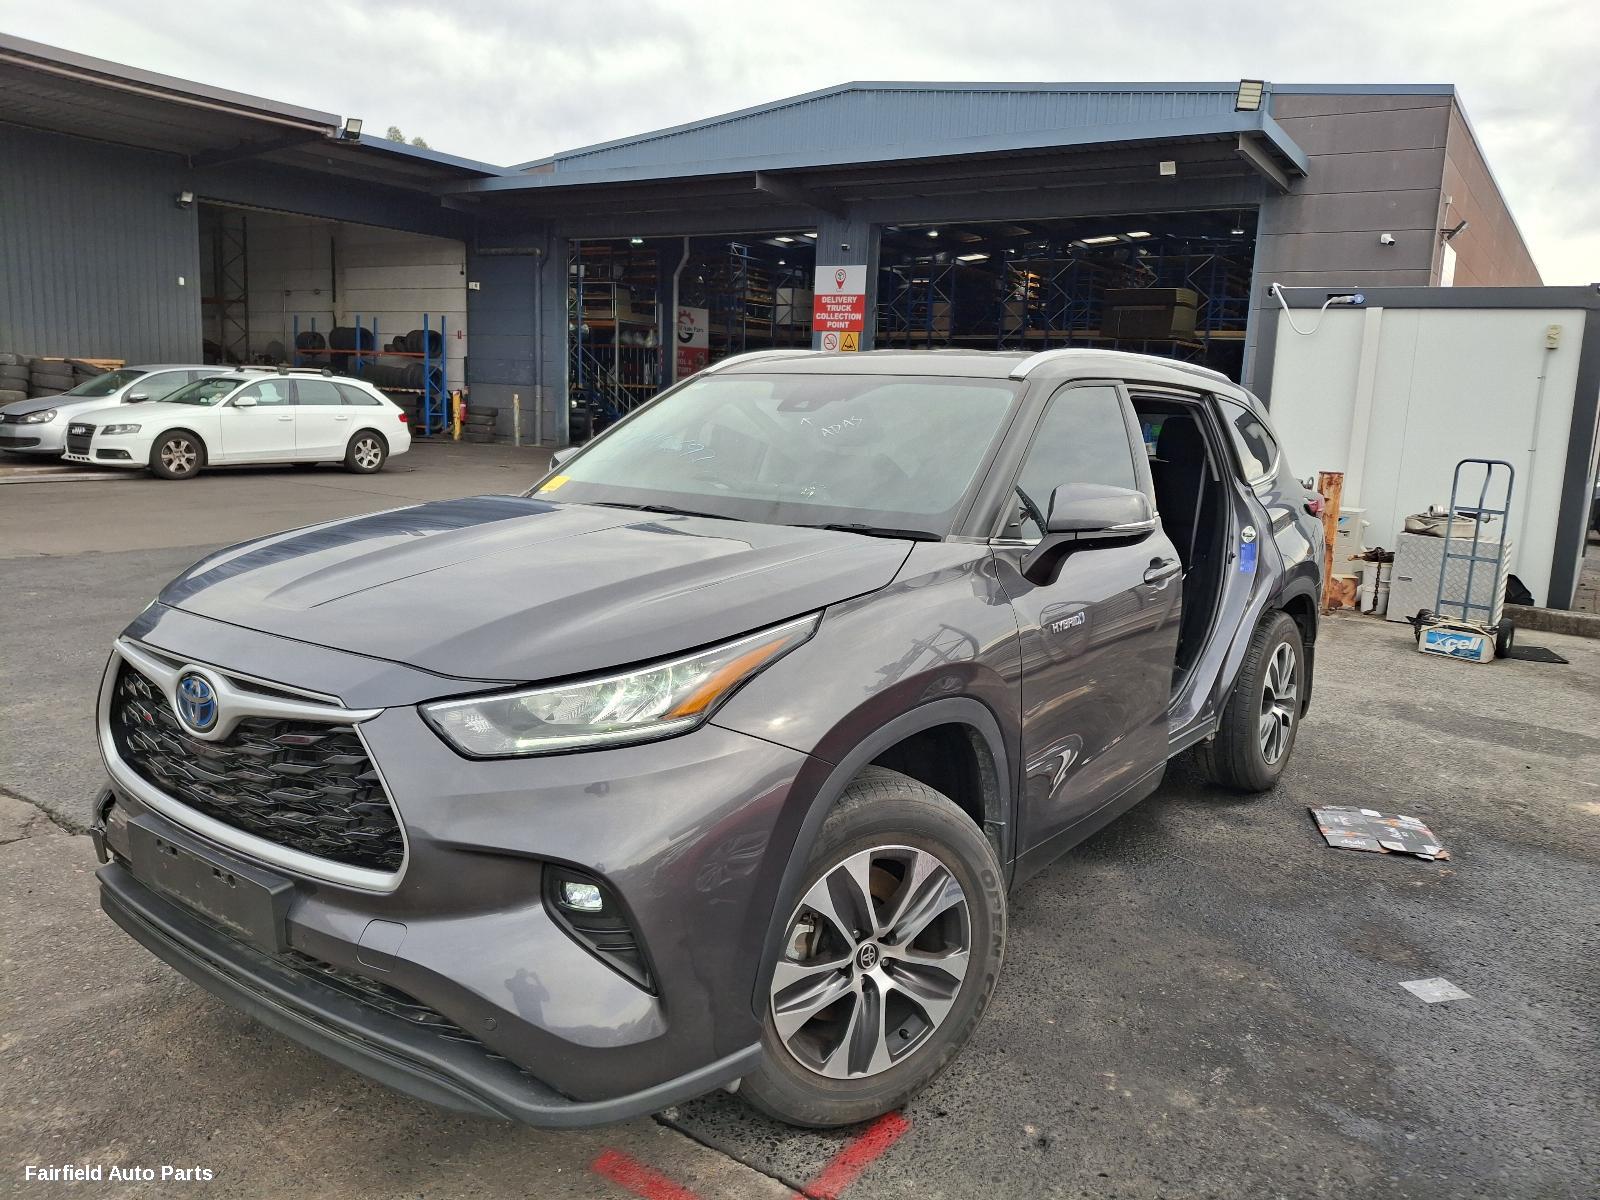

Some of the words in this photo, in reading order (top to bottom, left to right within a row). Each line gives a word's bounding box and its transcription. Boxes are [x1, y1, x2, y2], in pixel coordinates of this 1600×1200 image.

[827, 321, 850, 329] POINT
[1051, 611, 1085, 634] HYBRID
[980, 868, 1001, 958] OPEN
